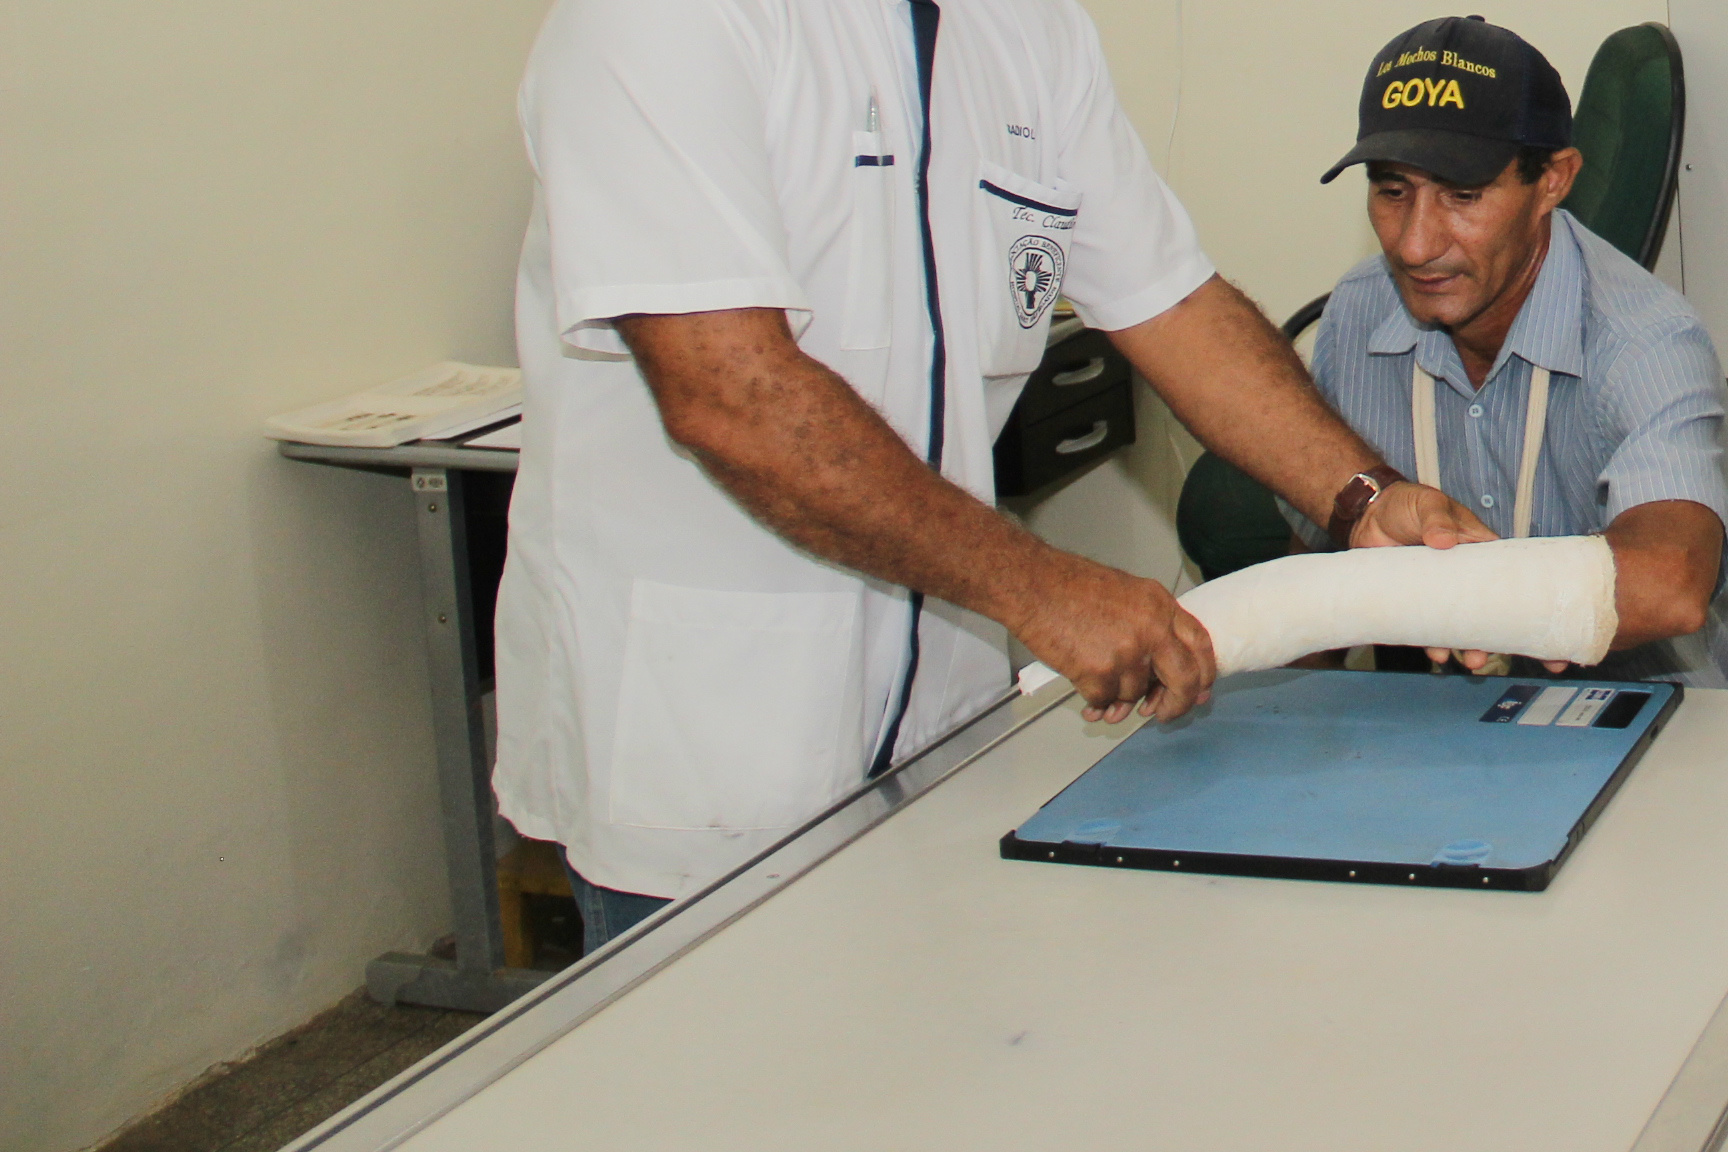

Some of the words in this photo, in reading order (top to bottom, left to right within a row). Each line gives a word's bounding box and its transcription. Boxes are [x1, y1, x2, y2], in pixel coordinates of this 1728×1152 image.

[1376, 61, 1393, 77] Los
[1441, 49, 1497, 79] Blancos
[1381, 77, 1465, 110] GOYA
